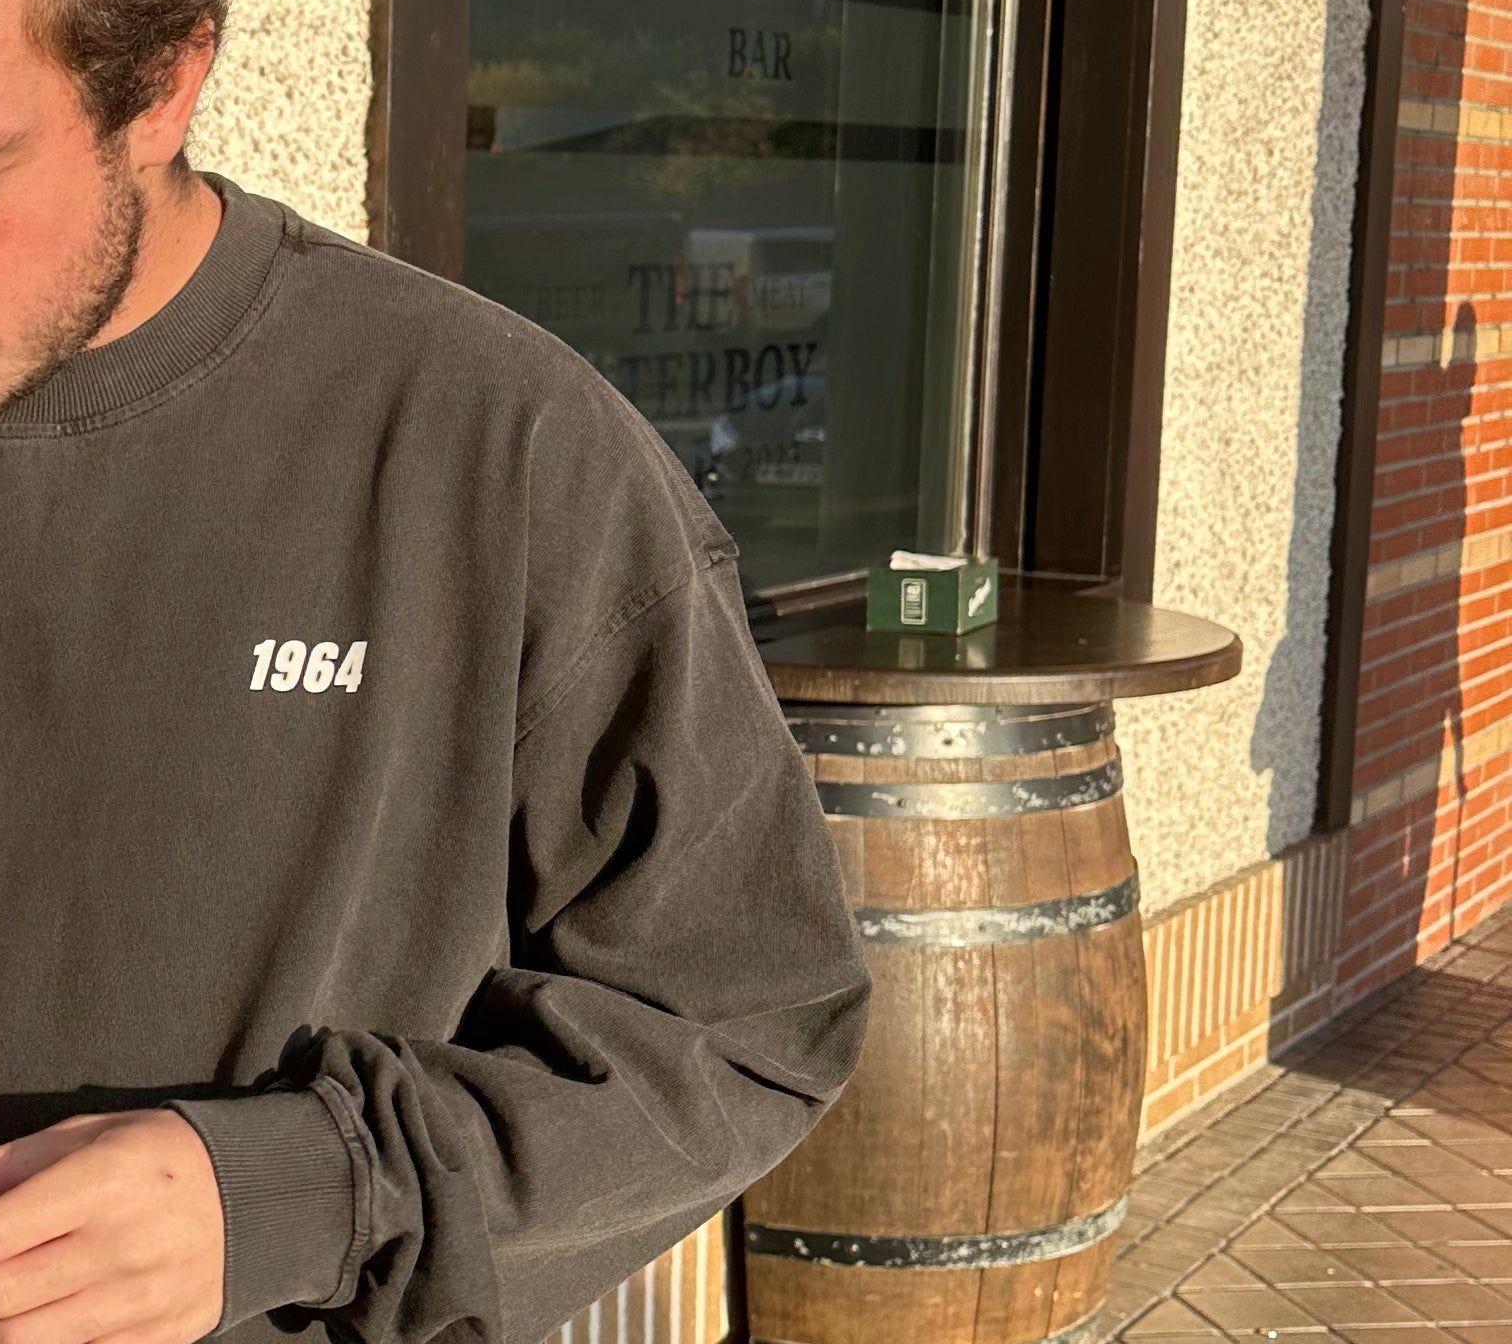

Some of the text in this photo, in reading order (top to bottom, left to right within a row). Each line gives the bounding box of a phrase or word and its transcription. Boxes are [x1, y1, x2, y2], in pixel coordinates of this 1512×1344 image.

[727, 27, 793, 82] BAR
[628, 262, 736, 335] THE
[249, 639, 368, 694] 1964
